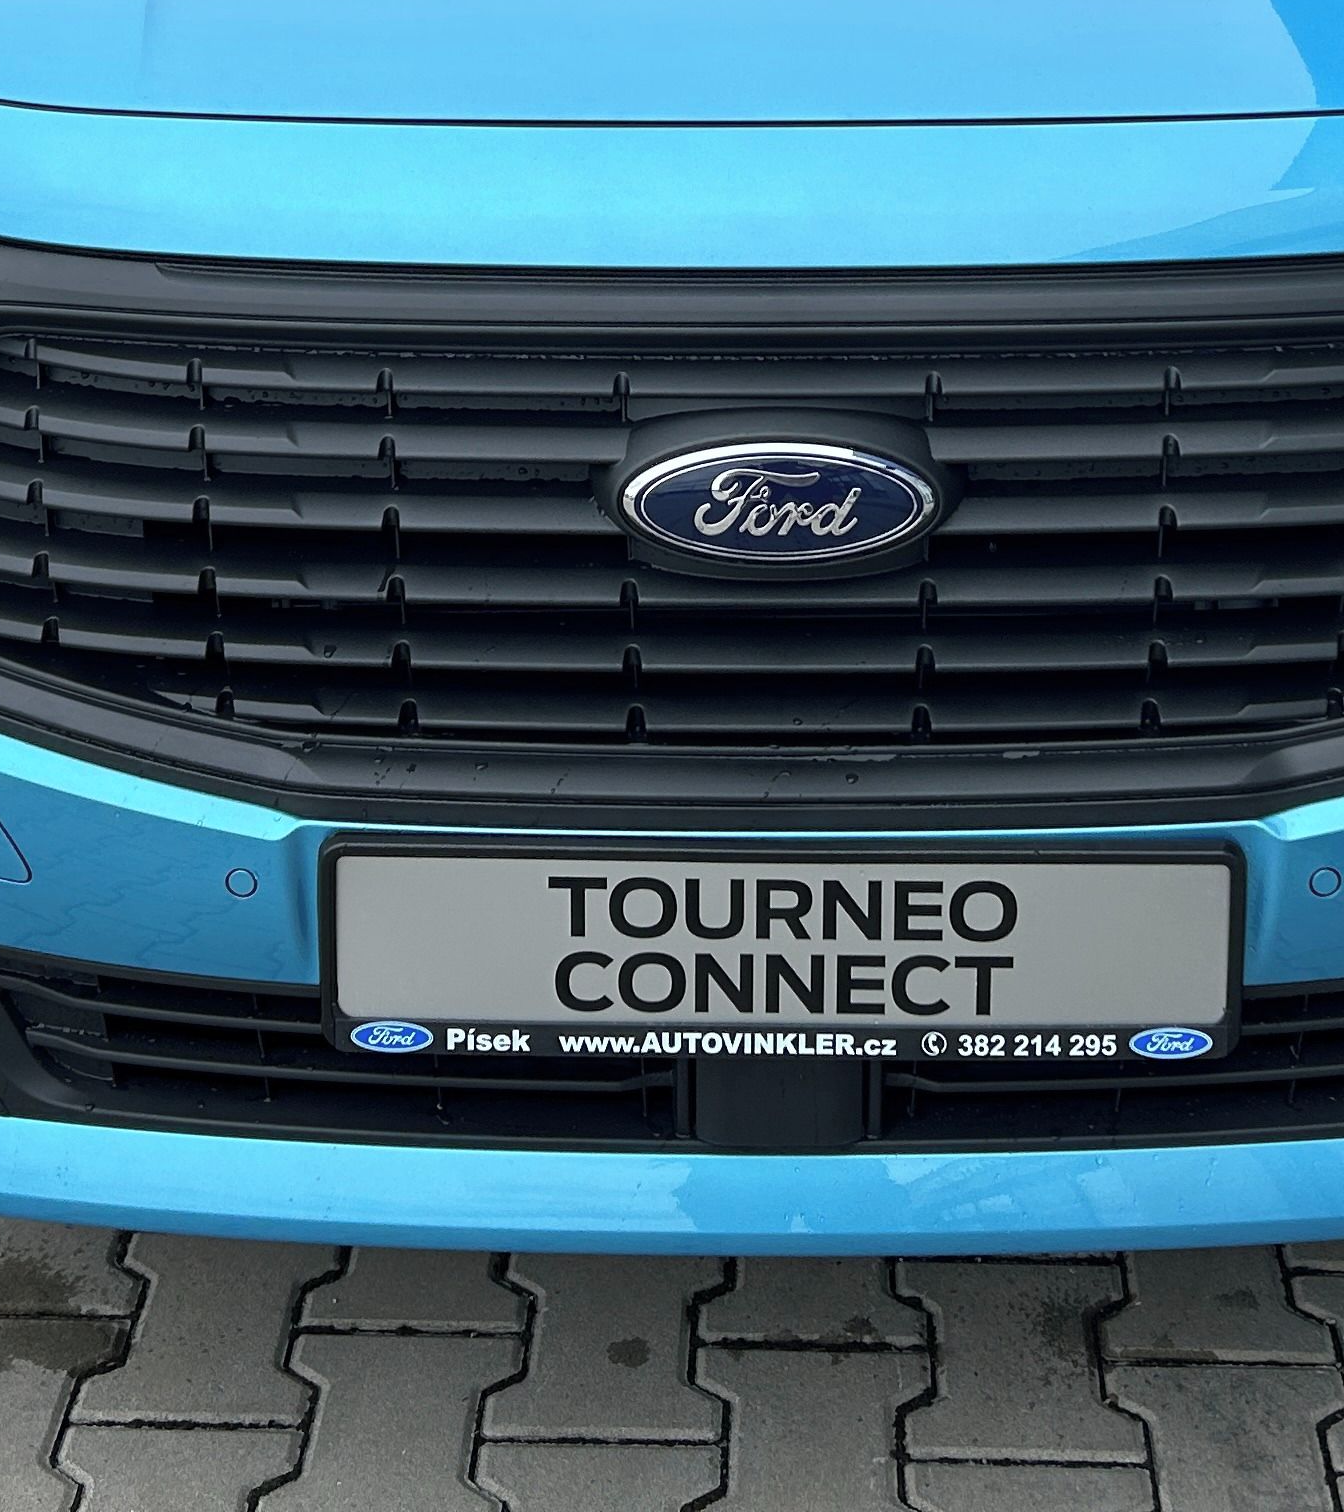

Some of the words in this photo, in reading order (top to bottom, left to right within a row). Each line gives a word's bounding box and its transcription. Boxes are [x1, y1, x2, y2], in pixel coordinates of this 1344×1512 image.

[693, 468, 862, 537] Ford
[547, 875, 1018, 943] TOURNEO
[554, 951, 1014, 1017] CONNECT
[368, 1026, 415, 1046] Ford
[446, 1027, 531, 1052] Písek
[558, 1030, 897, 1056] www.AUTOVINKLER.cz
[957, 1034, 1006, 1056] 382
[1013, 1034, 1062, 1056] 214
[1068, 1034, 1117, 1056] 295
[1145, 1032, 1194, 1052] Ford
